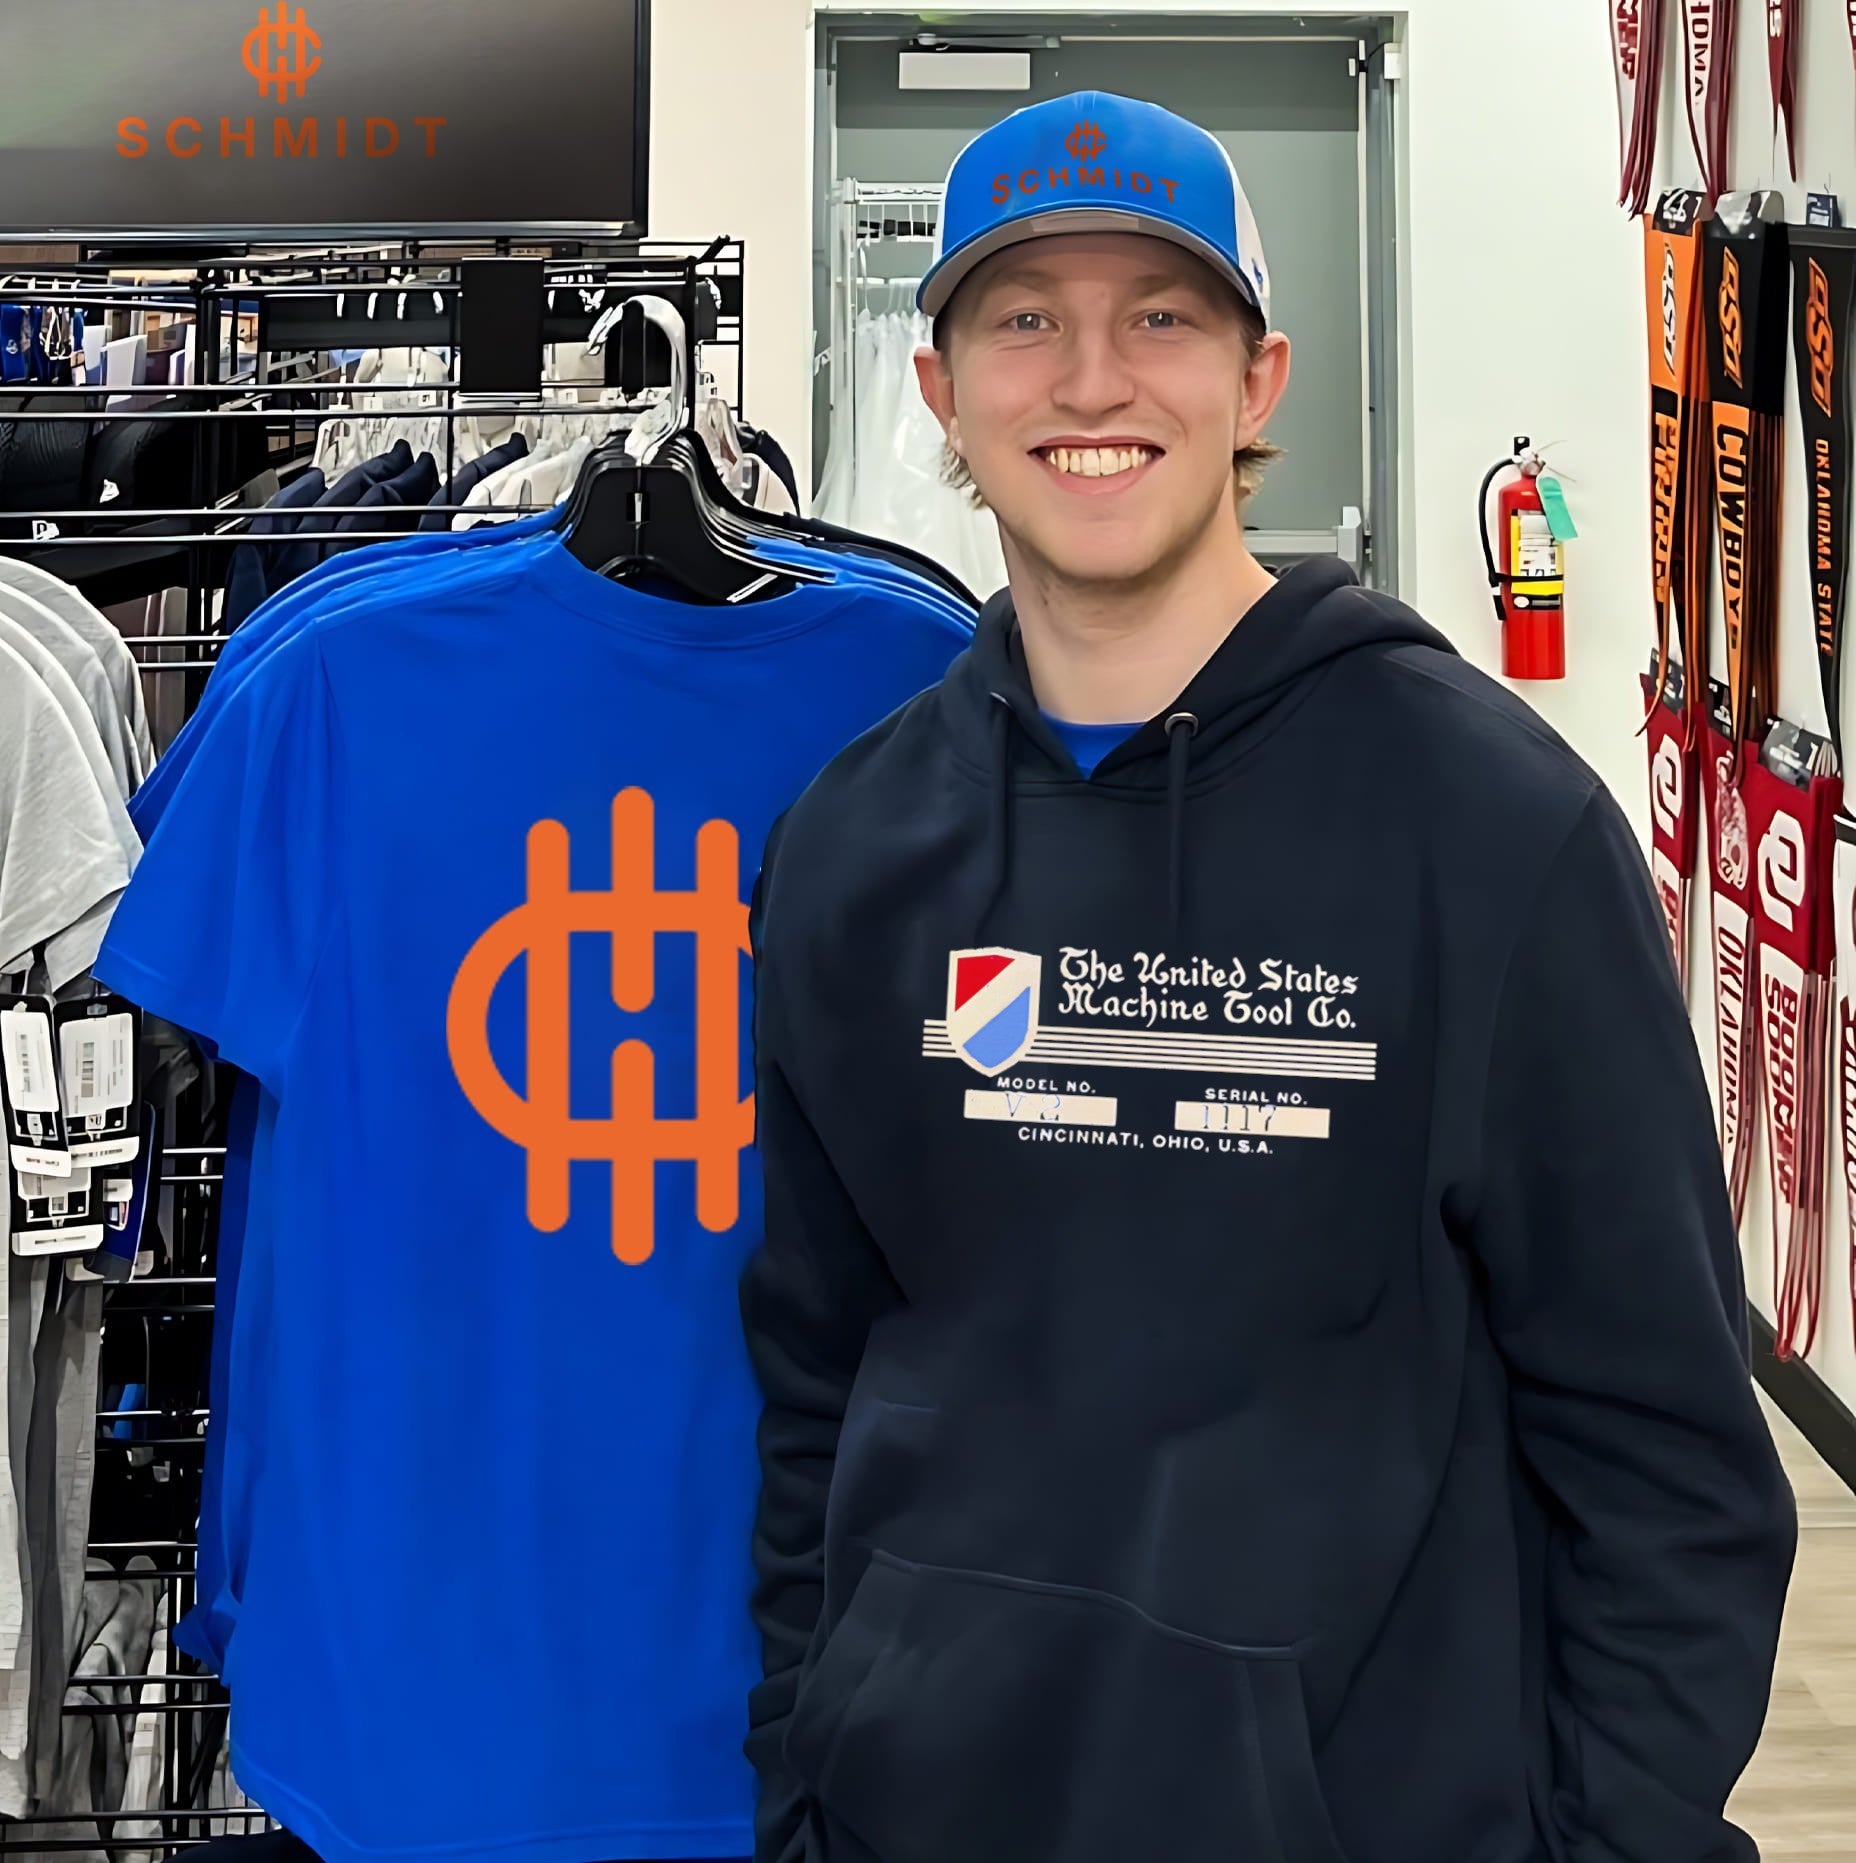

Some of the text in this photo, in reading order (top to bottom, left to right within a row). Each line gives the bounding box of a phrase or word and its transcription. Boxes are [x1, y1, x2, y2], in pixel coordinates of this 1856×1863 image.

[115, 116, 447, 158] SCHMIDT
[991, 166, 1179, 204] SCHMIDT
[1815, 438, 1833, 656] OKLAHOMA STATE
[1059, 946, 1359, 995] The United States
[1058, 981, 1357, 1029] Machine Tool Co.
[1717, 925, 1745, 1143] OKLAHOMA
[997, 1077, 1097, 1095] MODEL NO.
[1204, 1088, 1308, 1106] SERIAL NO.
[1018, 1126, 1274, 1155] CINCINNATI, OHIO, U.S.A.
